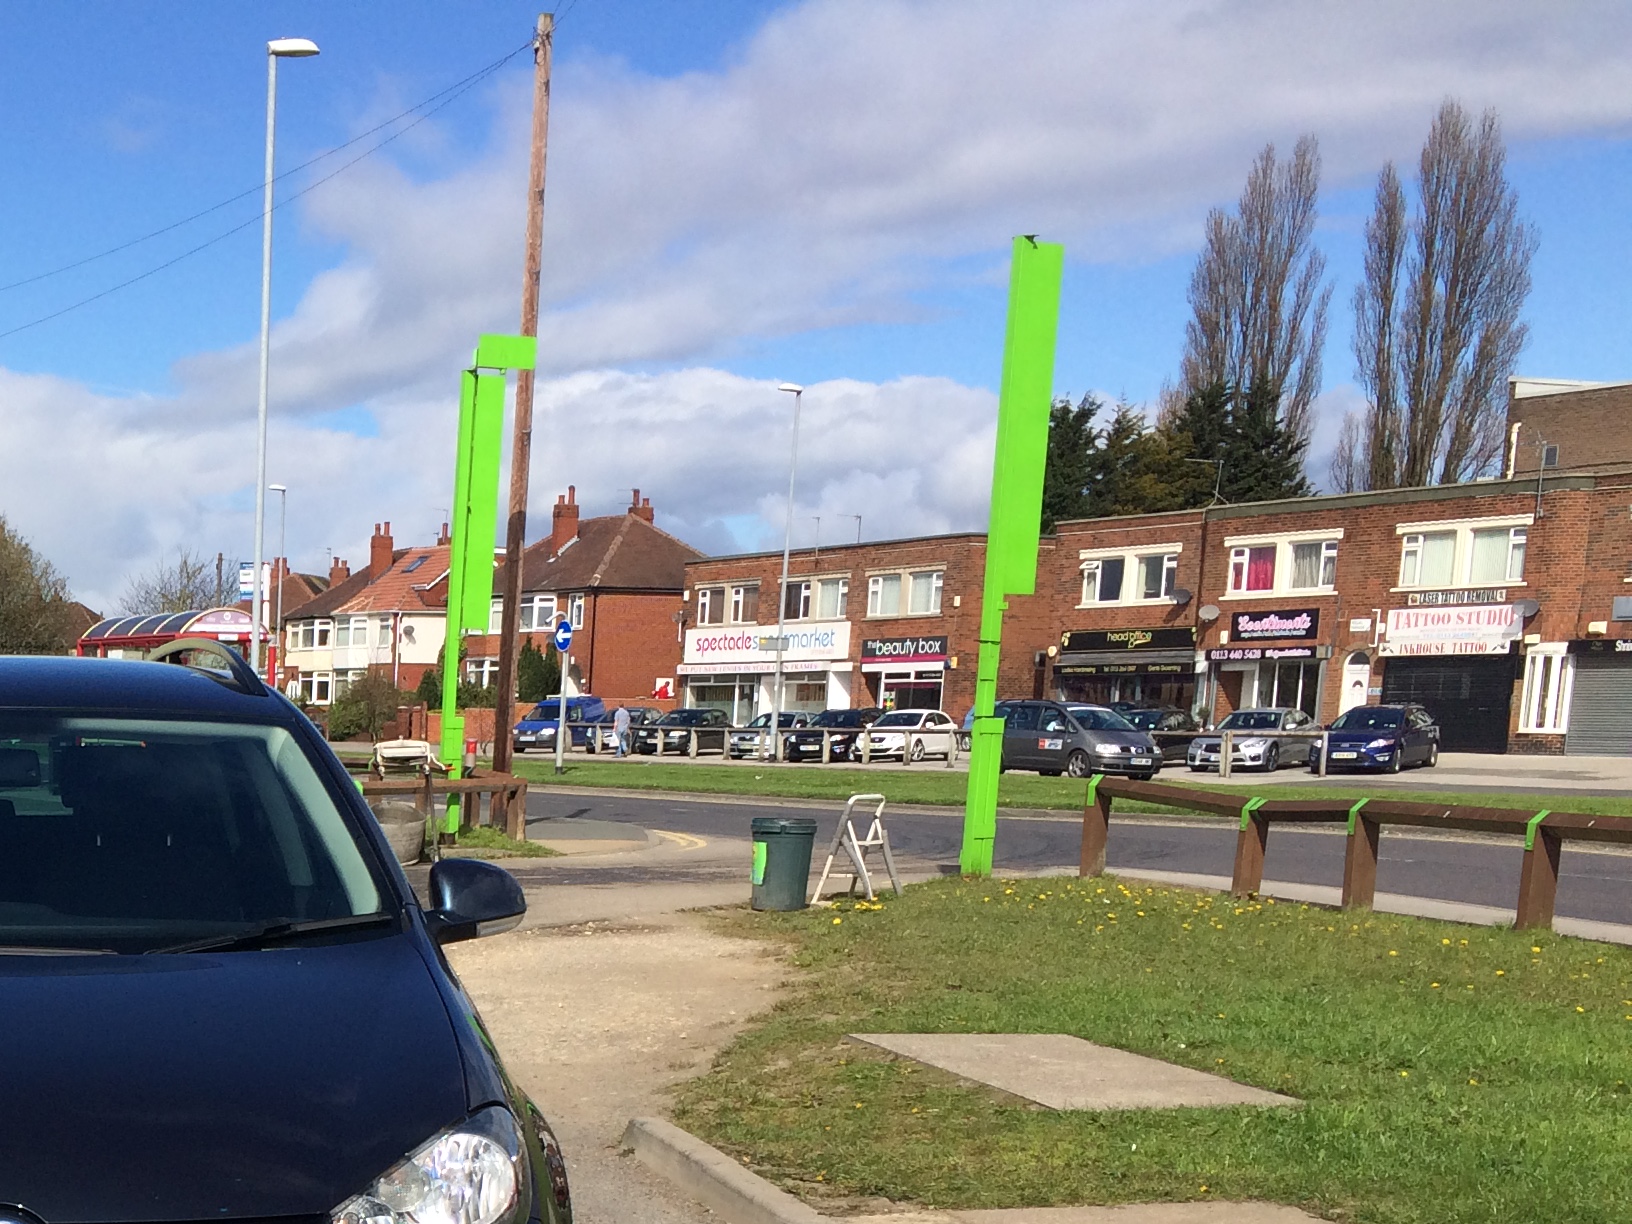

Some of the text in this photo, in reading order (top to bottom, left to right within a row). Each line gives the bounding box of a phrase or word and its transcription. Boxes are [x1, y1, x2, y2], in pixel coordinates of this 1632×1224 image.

[1419, 593, 1440, 604] LASER
[1393, 608, 1515, 630] TATTOO STUDIO
[1107, 631, 1129, 642] head
[876, 638, 917, 657] beauty
[918, 638, 941, 654] box
[1399, 642, 1488, 654] INKHOUSE TATTOO
[1210, 650, 1228, 660] 0113
